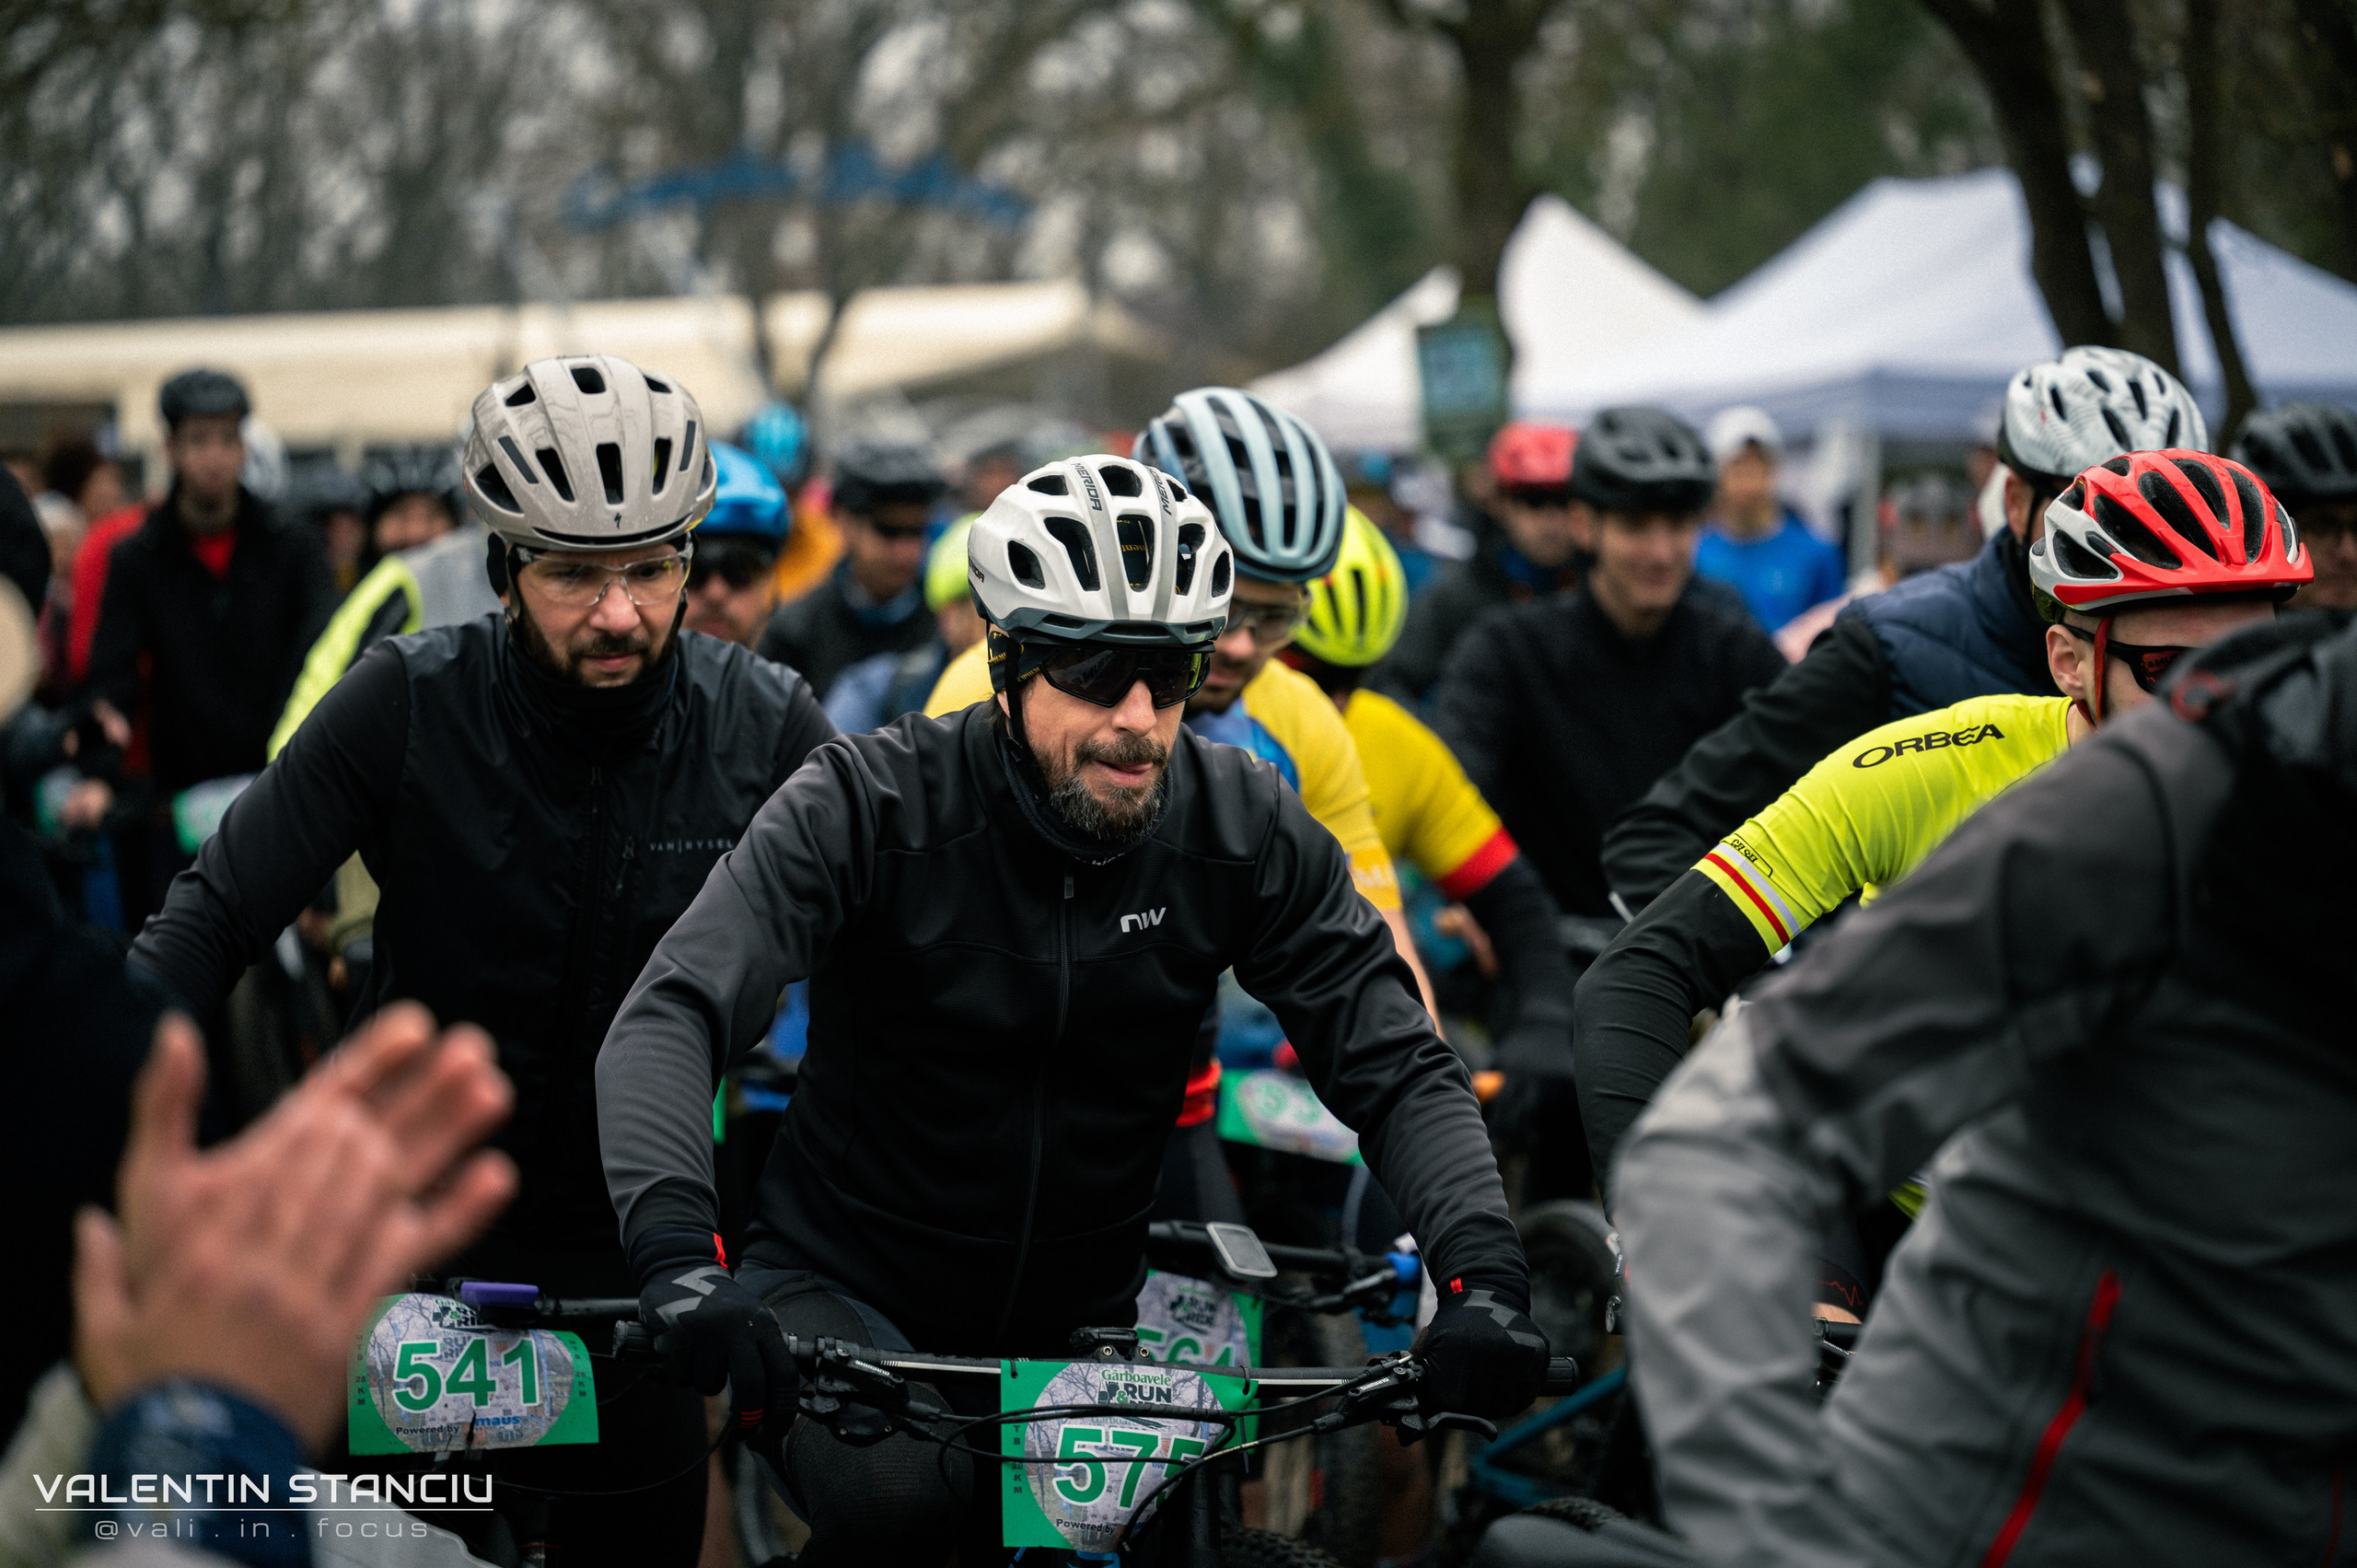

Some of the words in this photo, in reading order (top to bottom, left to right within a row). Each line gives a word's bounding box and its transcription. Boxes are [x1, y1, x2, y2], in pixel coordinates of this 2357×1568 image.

[1071, 462, 1103, 511] MERIDA
[1852, 724, 2005, 769] ORBEA
[392, 1338, 540, 1413] 541
[1101, 1369, 1171, 1386] Gârboavele
[1123, 1383, 1171, 1403] RUN
[396, 1425, 443, 1435] Powered
[447, 1424, 459, 1434] by
[1056, 1518, 1102, 1532] Powered
[1105, 1523, 1116, 1536] by
